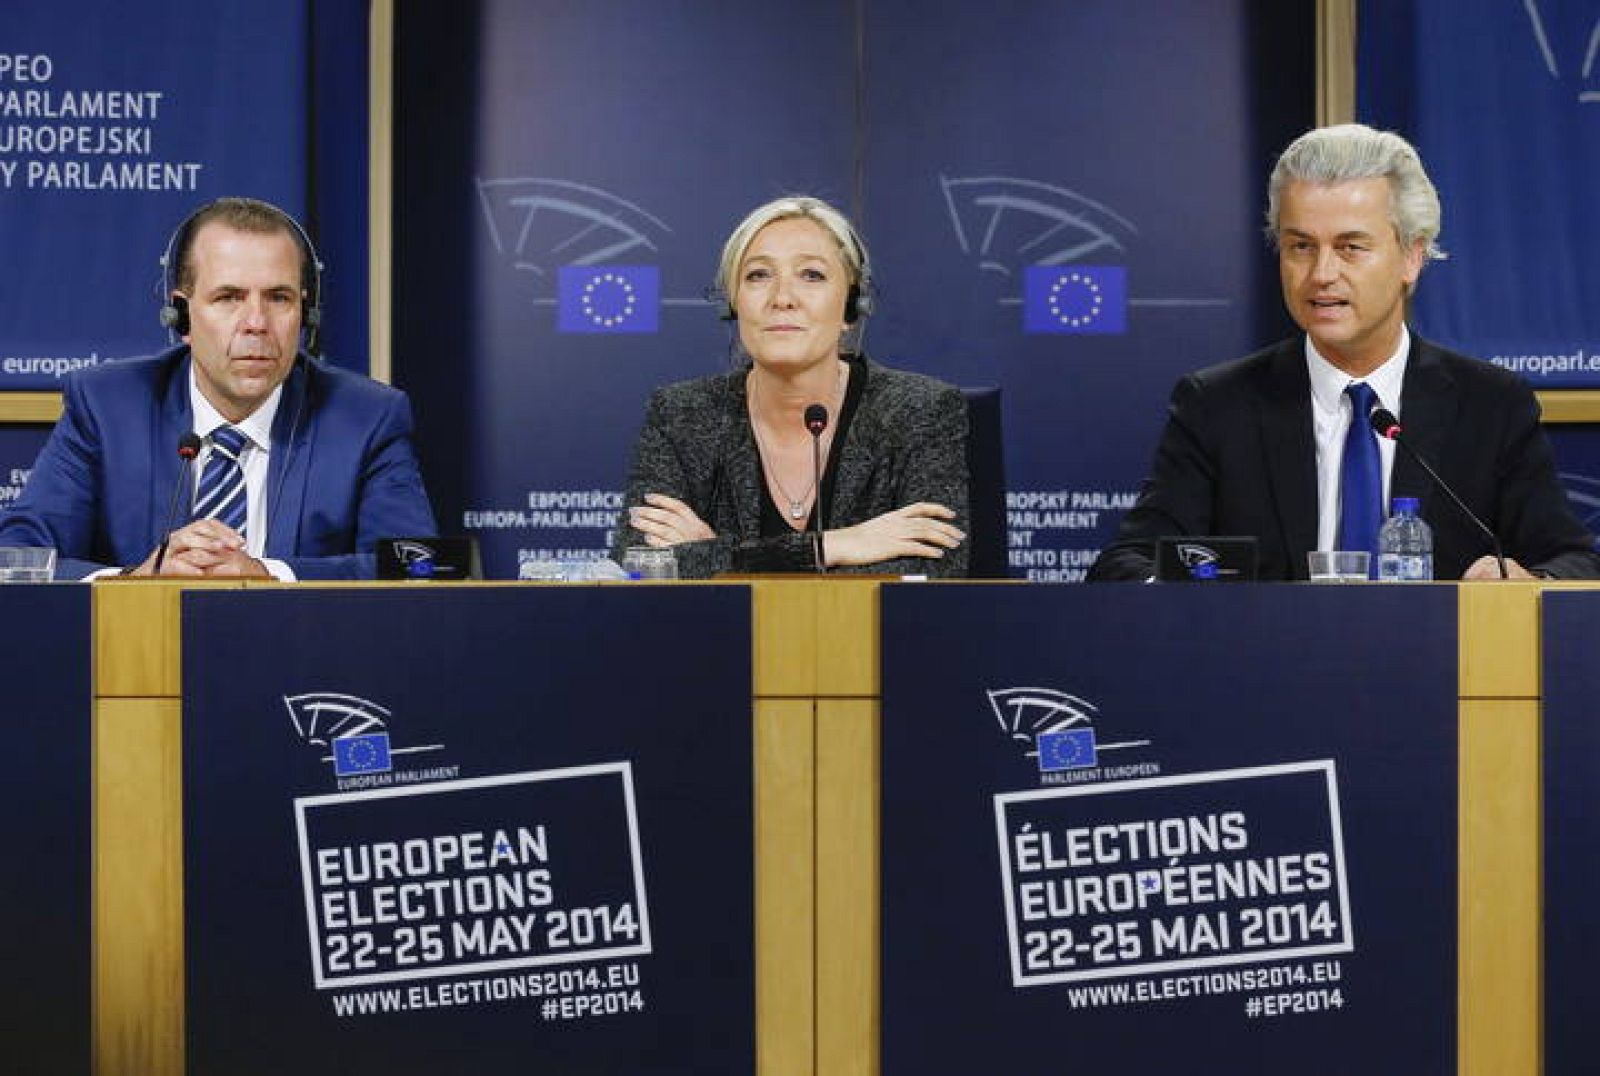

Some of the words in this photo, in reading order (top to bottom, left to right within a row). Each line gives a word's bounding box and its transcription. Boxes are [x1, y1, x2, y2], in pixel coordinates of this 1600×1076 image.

[0, 90, 162, 119] ARLAMENT
[28, 161, 202, 190] PARLAMENT
[338, 774, 392, 790] EUROPEAN
[395, 766, 459, 784] PARLIAMENT
[318, 825, 549, 886] EUROPEAN
[1015, 811, 1247, 872] ÉLECTIONS
[321, 869, 553, 929] ELECTIONS
[1020, 852, 1331, 921] EUROPÉENNES
[326, 924, 444, 972] 22-25
[452, 914, 536, 958] MAY
[546, 903, 639, 948] 2014
[1025, 921, 1141, 970] 22-25
[1152, 911, 1230, 957] MAI
[1240, 900, 1336, 947] 2014
[333, 963, 640, 1017] WWW.ELECTIONS2014.EU
[542, 989, 644, 1020] #EP2014
[1068, 960, 1342, 1008] WWW.ELECTIONS2014.EU
[1245, 989, 1344, 1018] #EP2014
